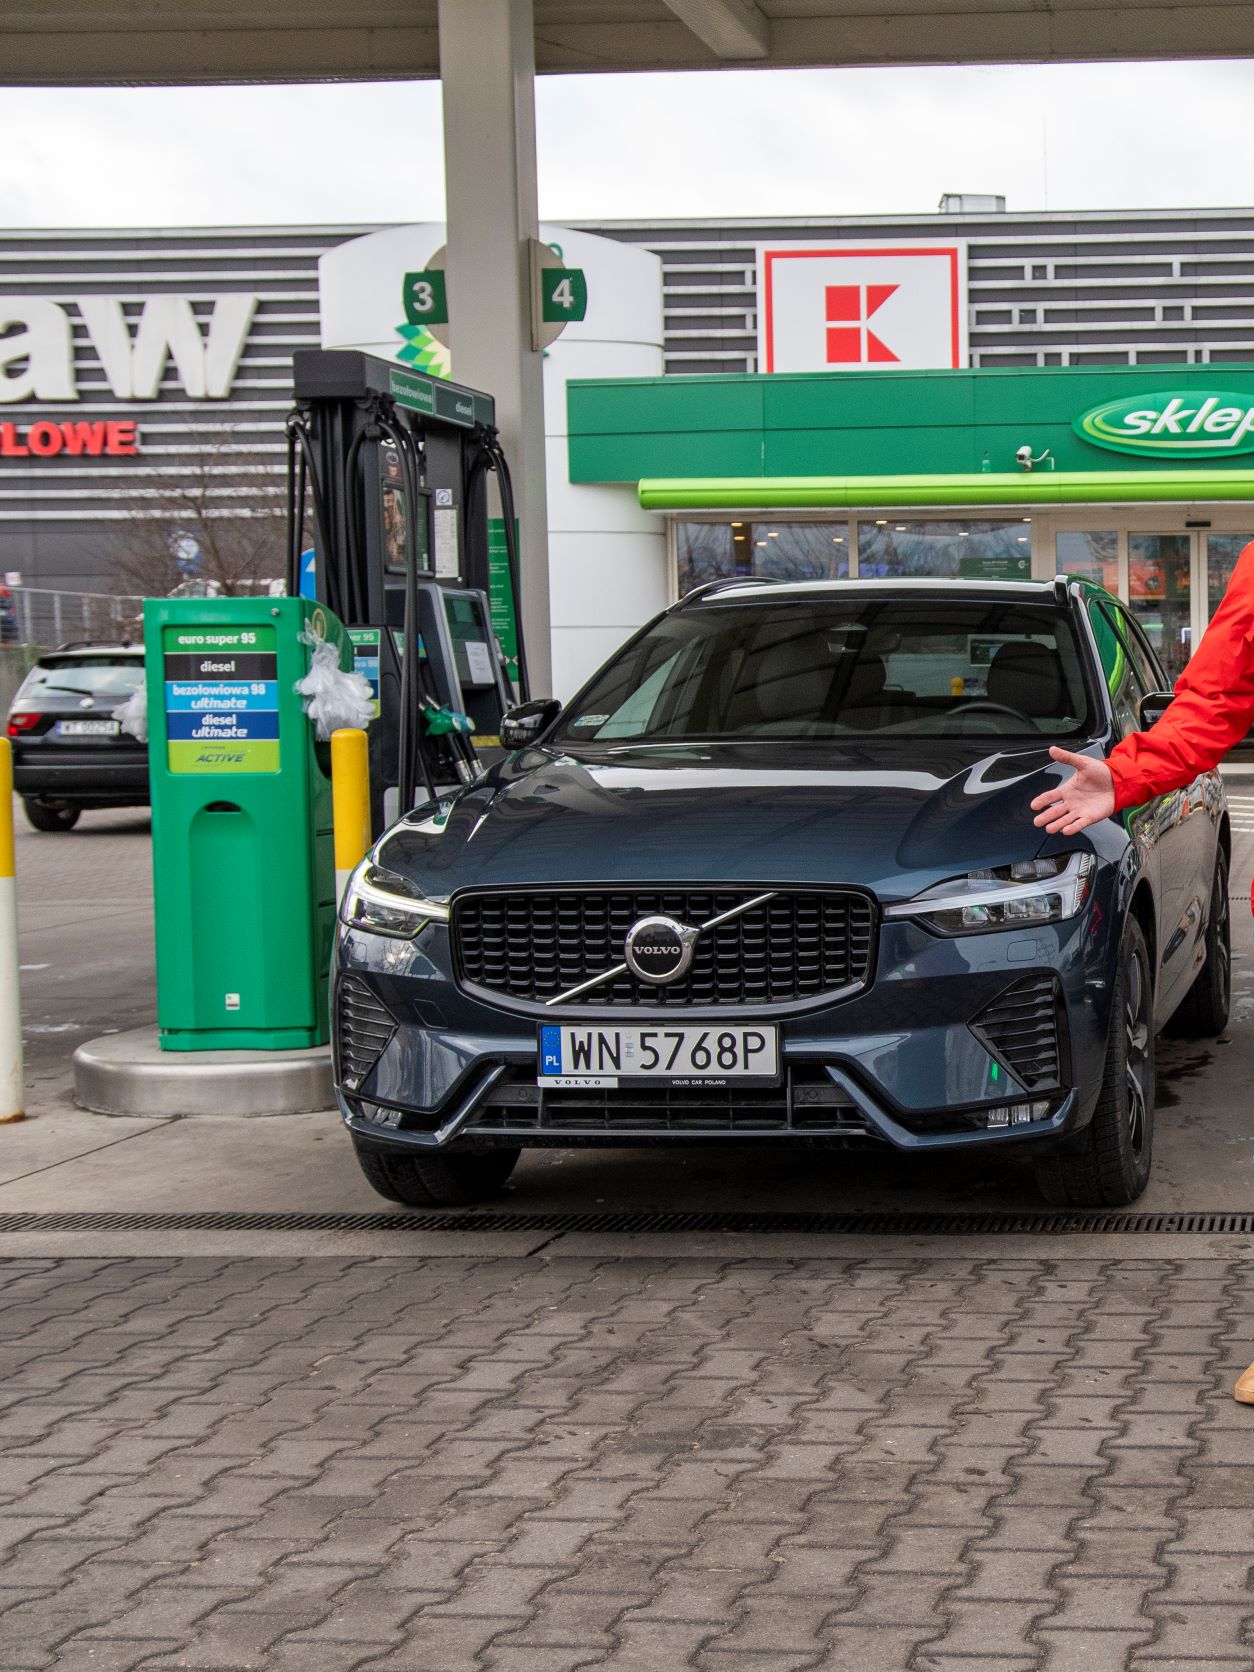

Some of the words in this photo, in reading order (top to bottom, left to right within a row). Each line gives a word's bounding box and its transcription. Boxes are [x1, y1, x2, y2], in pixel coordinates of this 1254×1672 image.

[412, 281, 435, 312] 3
[551, 278, 574, 309] 4
[825, 284, 901, 363] K
[455, 401, 472, 416] diesel
[178, 635, 204, 644] euro
[205, 635, 239, 646] super
[240, 632, 256, 644] 95
[200, 661, 236, 672] diesel
[250, 683, 266, 695] 98
[191, 697, 248, 709] ultimate
[202, 714, 237, 725] diesel
[191, 726, 248, 738] ultimate
[195, 754, 246, 763] ACTIVE
[633, 946, 681, 955] VOLVO
[570, 1031, 622, 1071] WN
[639, 1031, 766, 1071] 5768P
[545, 1055, 560, 1067] PL
